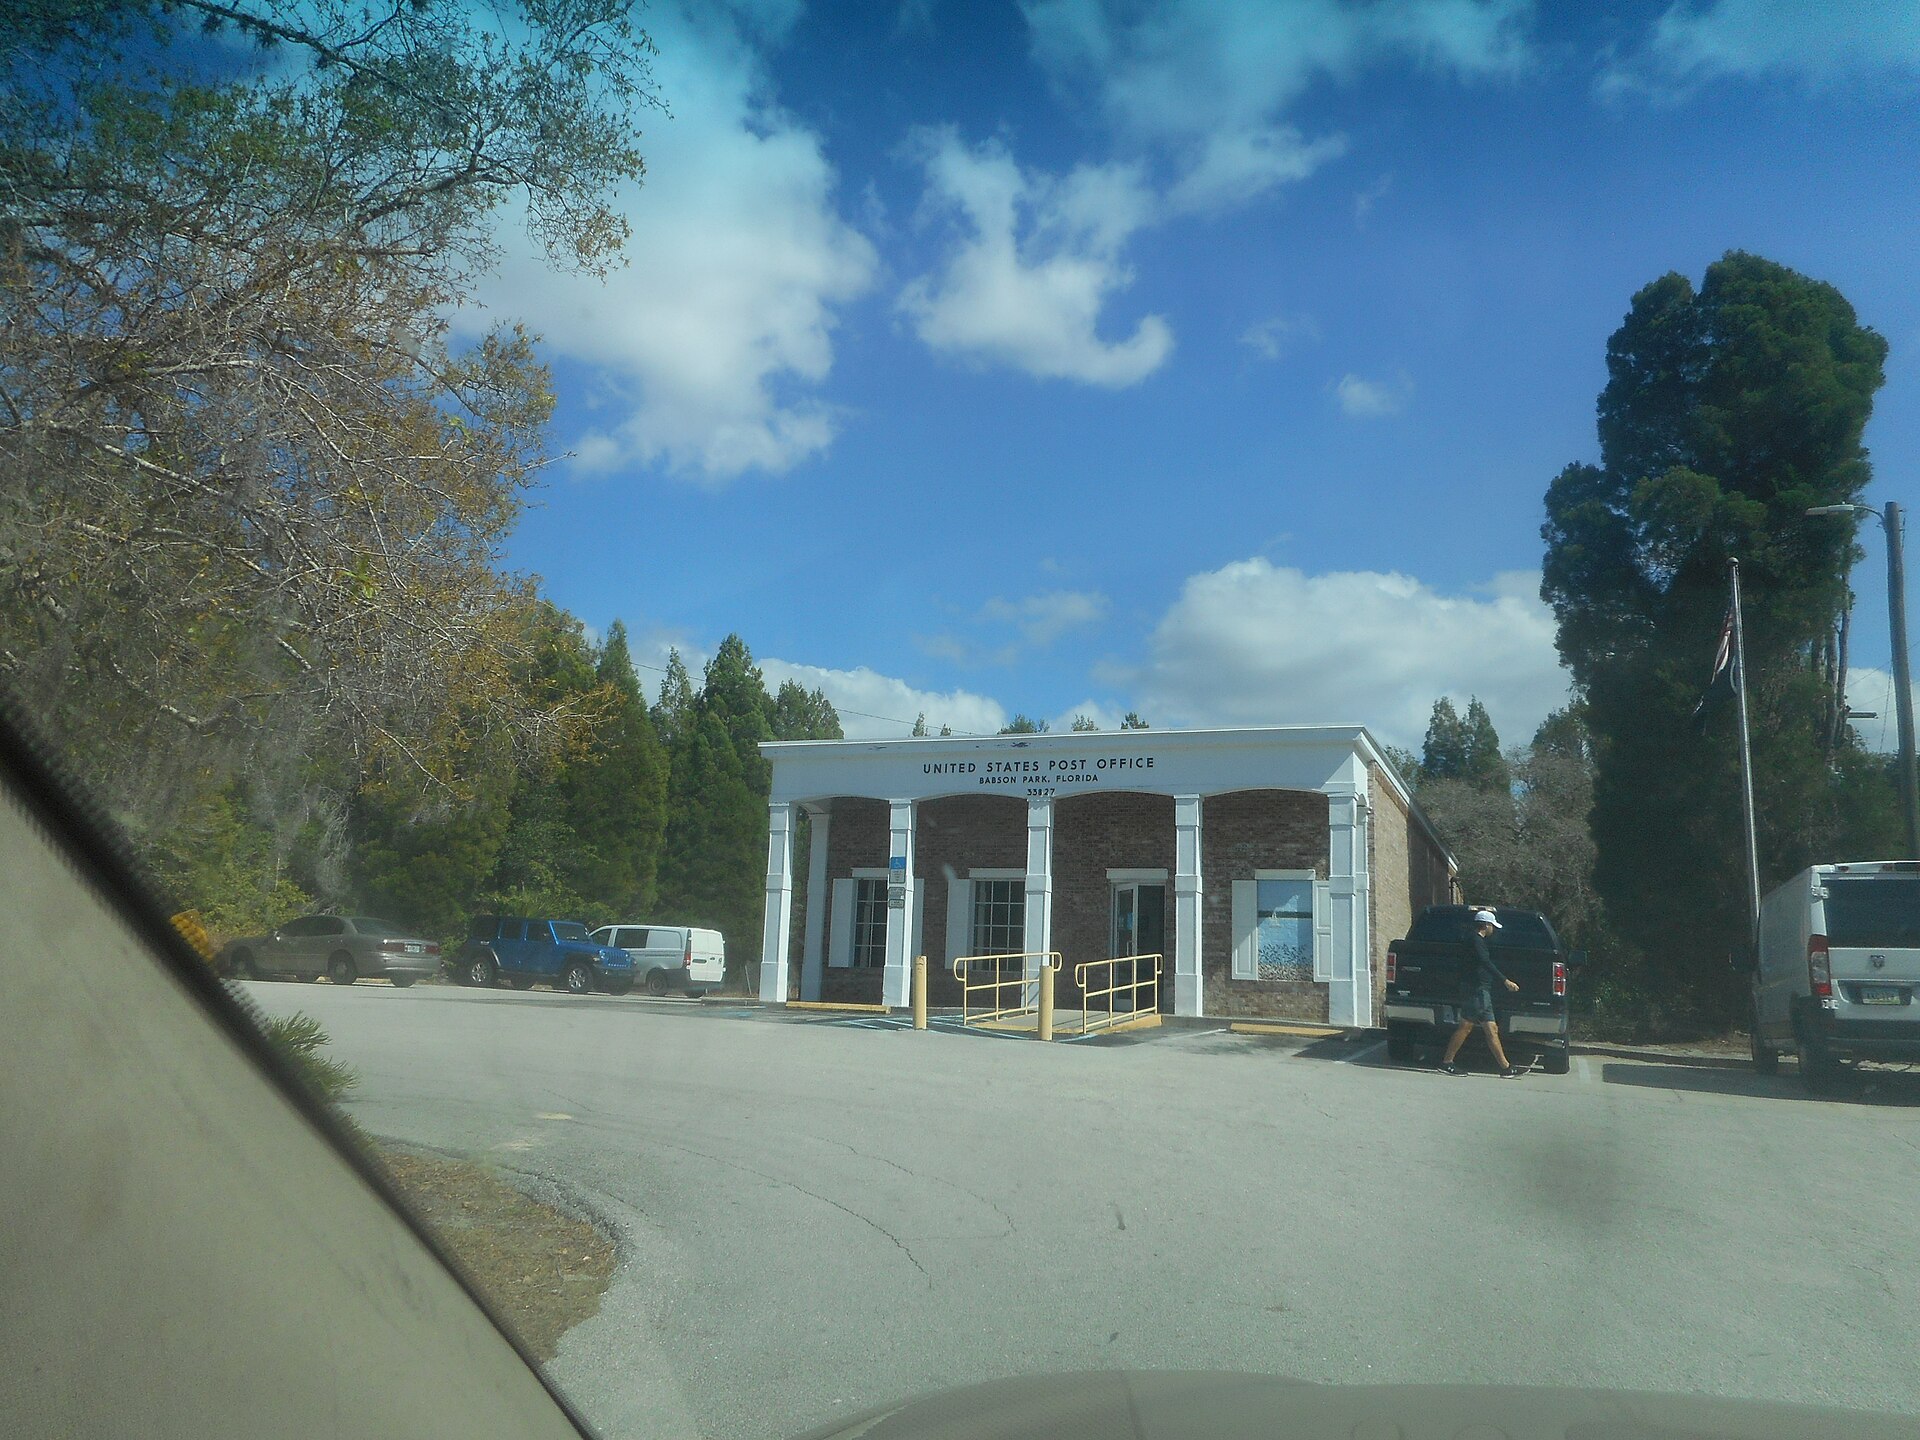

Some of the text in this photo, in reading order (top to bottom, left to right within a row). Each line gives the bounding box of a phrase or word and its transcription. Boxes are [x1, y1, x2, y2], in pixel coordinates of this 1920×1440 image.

[923, 758, 1154, 774] UNITED STATES POST OFFICE
[979, 776, 1017, 785] BABSON
[1056, 774, 1099, 783] FLORIDA
[1027, 788, 1055, 796] 33827
